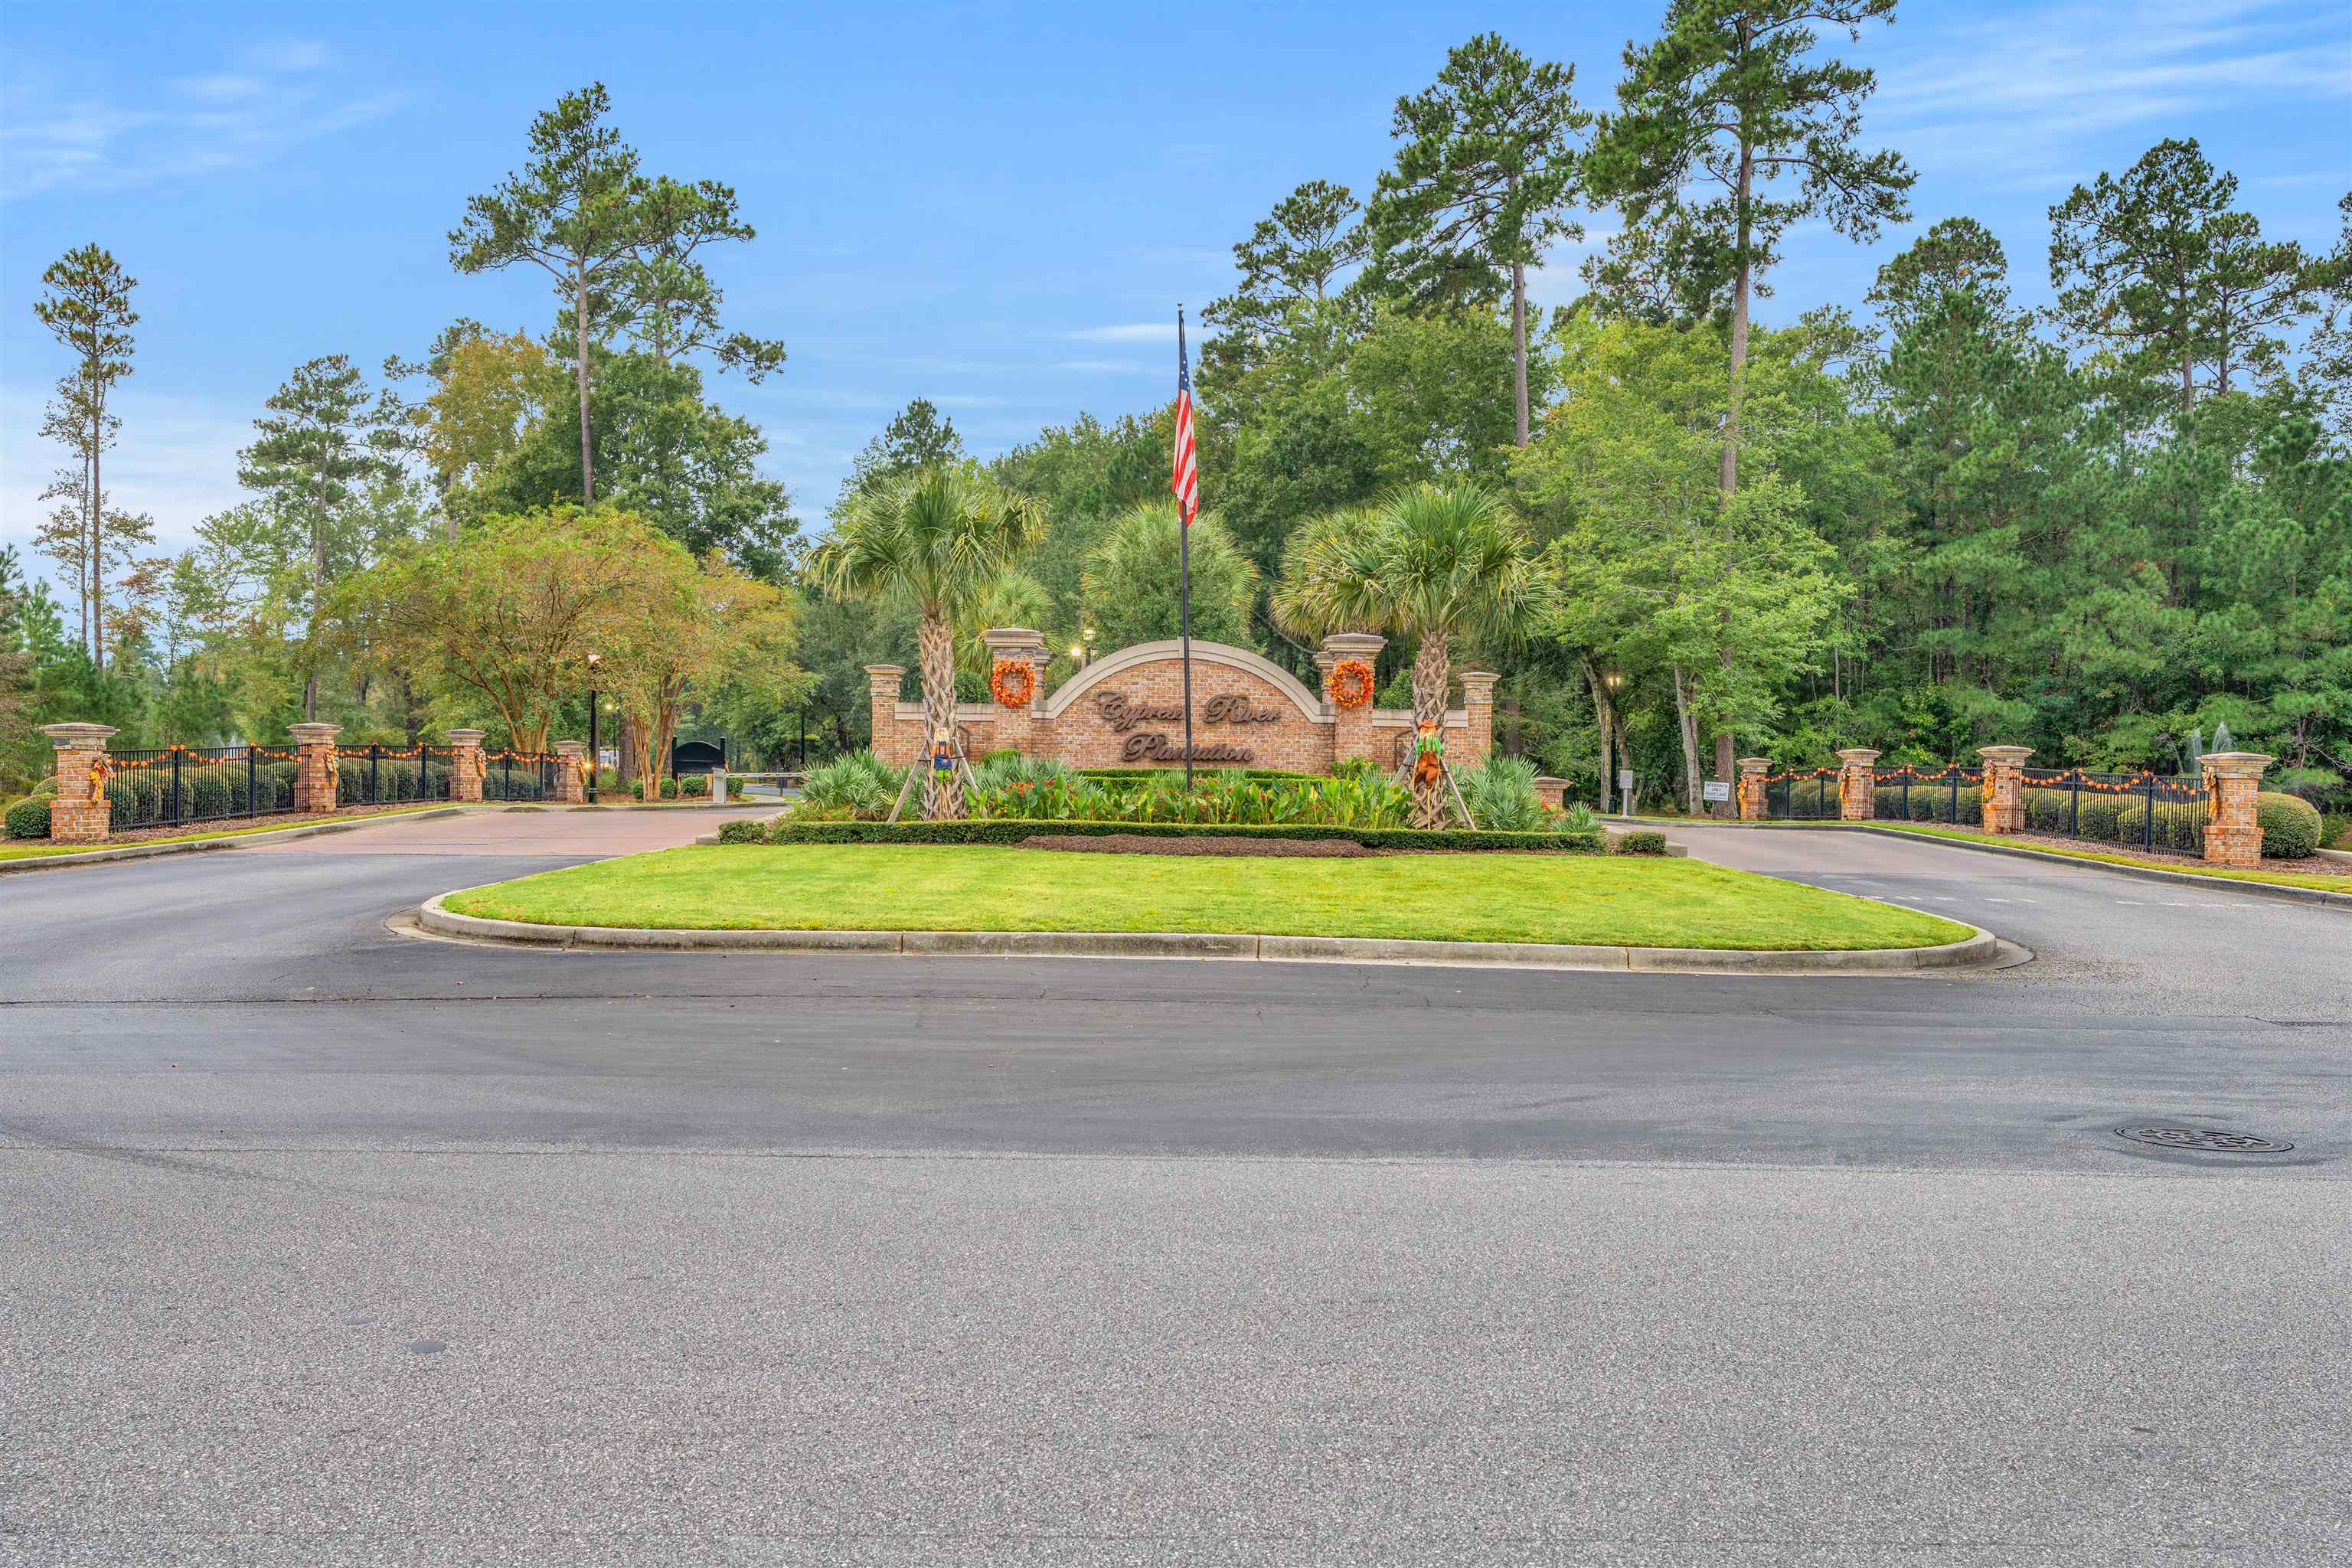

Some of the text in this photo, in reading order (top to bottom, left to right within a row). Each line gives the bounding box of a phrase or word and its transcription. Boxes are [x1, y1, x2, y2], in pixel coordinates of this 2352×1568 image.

[1096, 691, 1282, 732] Cypress River
[1122, 733, 1256, 762] Plantation
